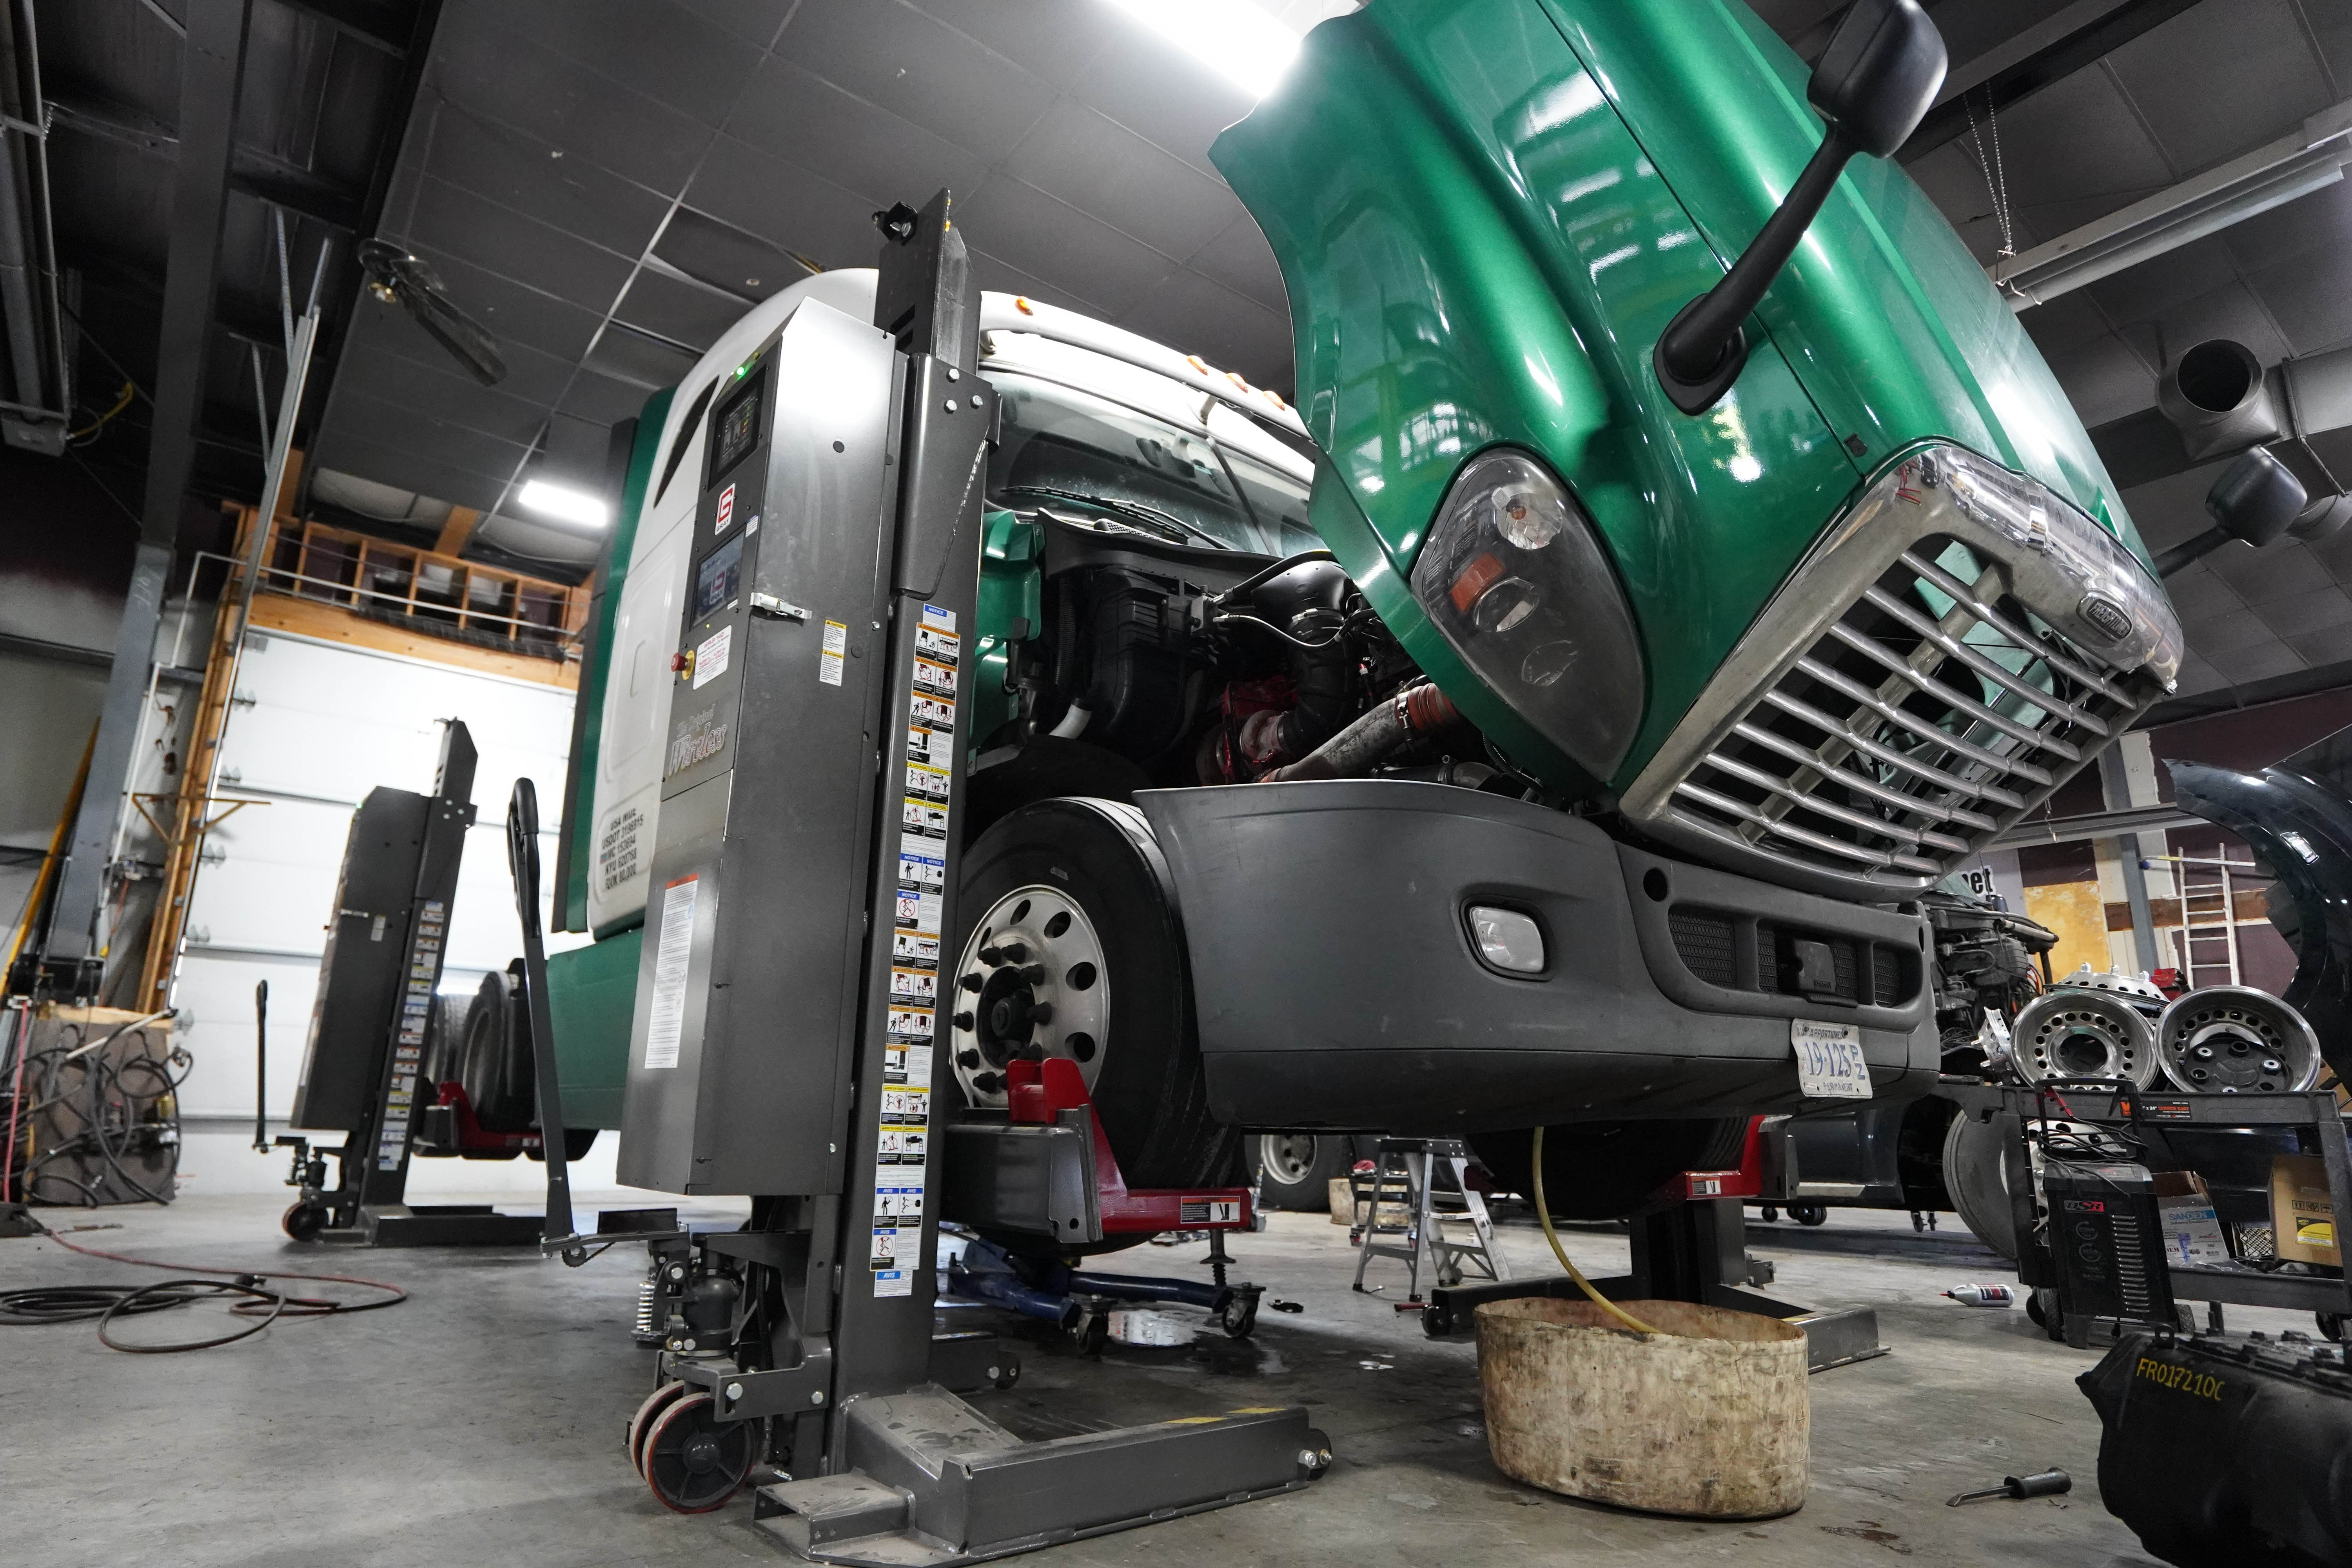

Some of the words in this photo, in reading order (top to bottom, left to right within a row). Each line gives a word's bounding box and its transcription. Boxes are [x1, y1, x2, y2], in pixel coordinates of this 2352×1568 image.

[716, 519, 729, 532] GRAY
[669, 722, 727, 776] Wireless
[602, 829, 620, 849] USDOT
[2067, 1201, 2101, 1211] DSR
[2136, 1357, 2225, 1401] FR017210C
